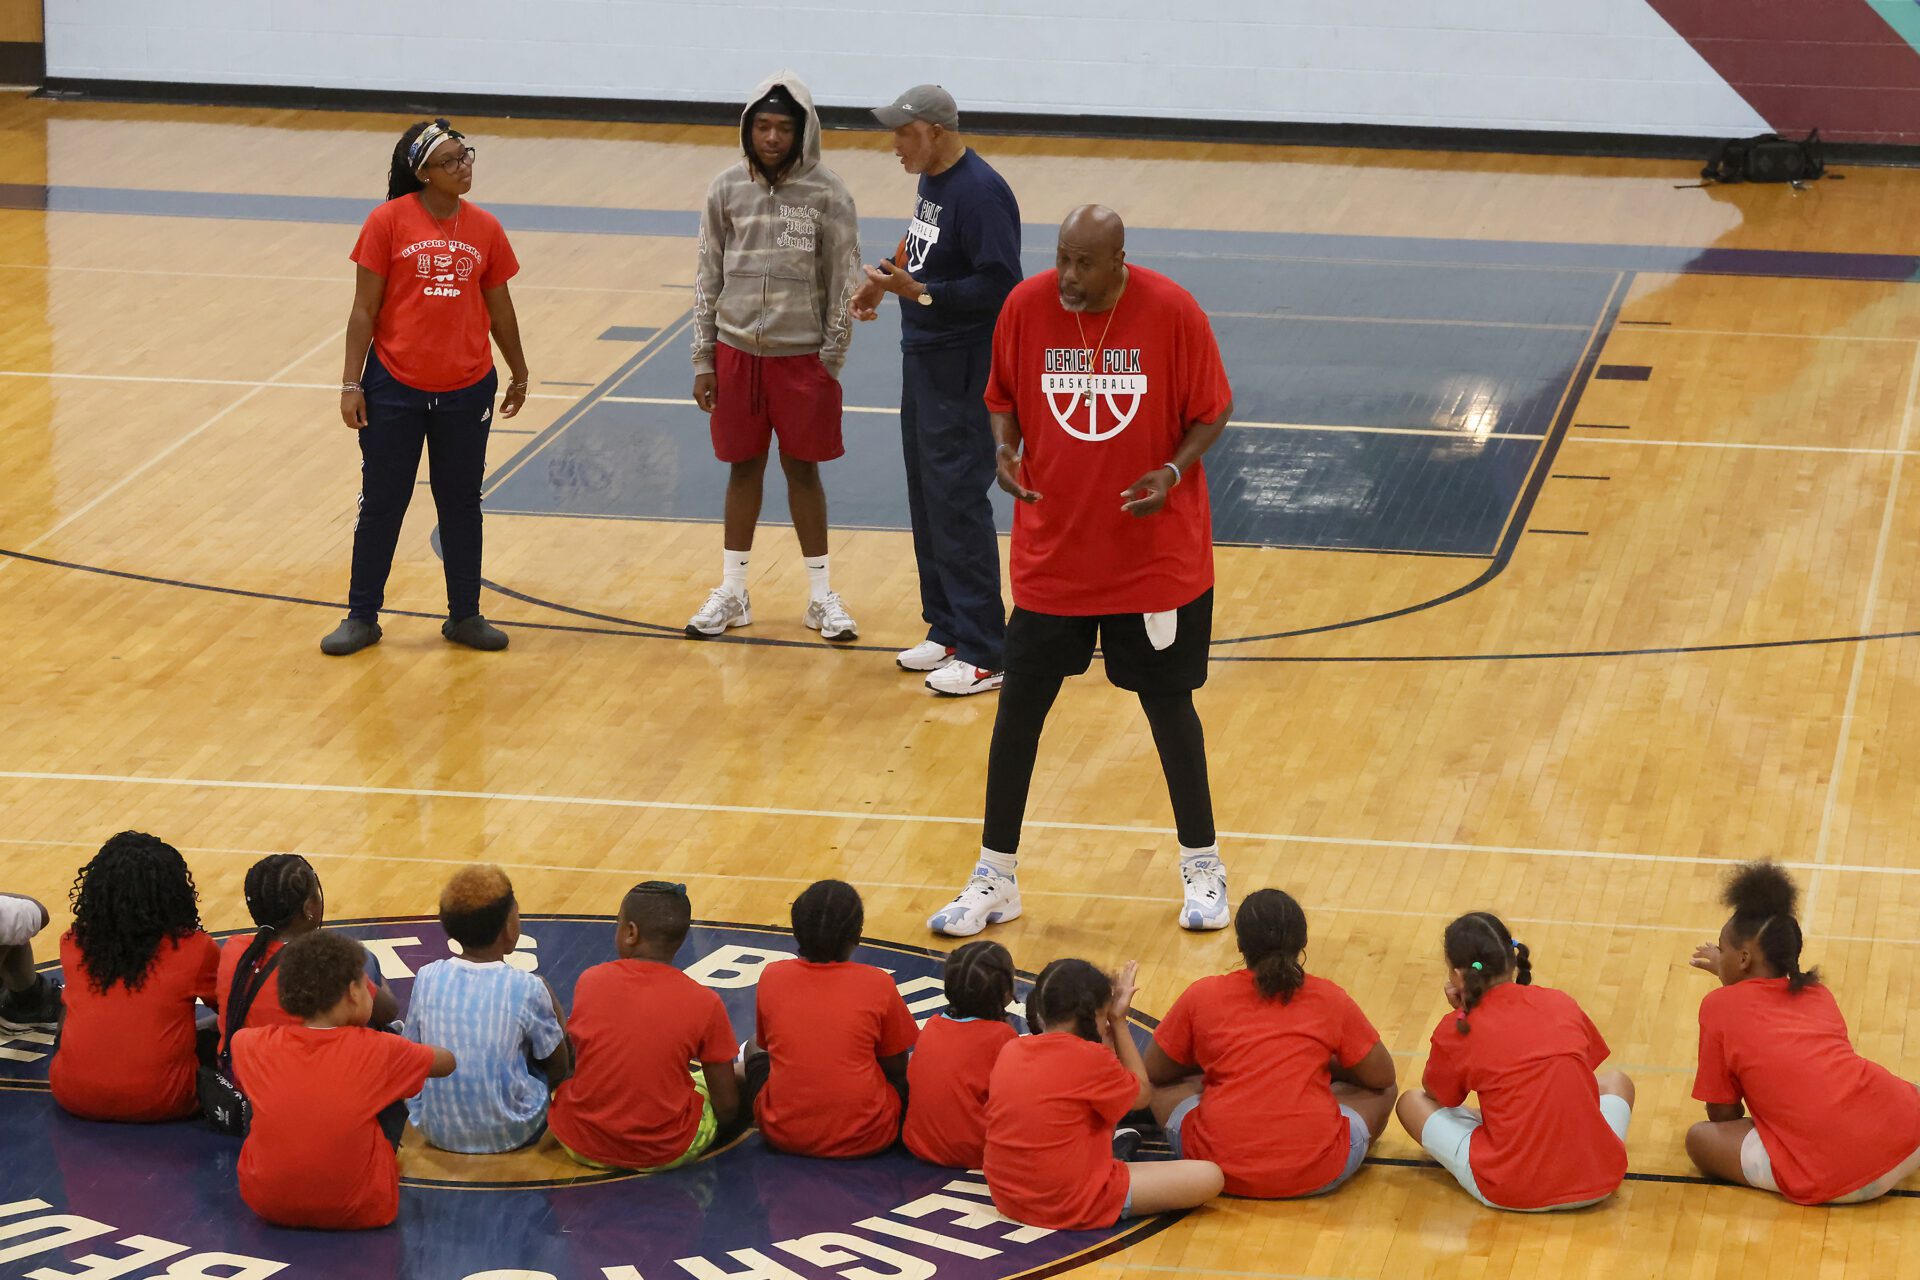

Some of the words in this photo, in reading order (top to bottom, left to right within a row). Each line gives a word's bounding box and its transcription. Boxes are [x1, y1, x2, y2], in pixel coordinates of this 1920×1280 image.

[920, 200, 943, 226] POLK
[402, 240, 446, 258] BEDFORD
[449, 240, 482, 264] HEIGHTS
[424, 287, 461, 297] CAMP
[1045, 349, 1094, 373] DERICK
[1103, 349, 1141, 373] POLK
[1050, 378, 1135, 389] BASKETBALL
